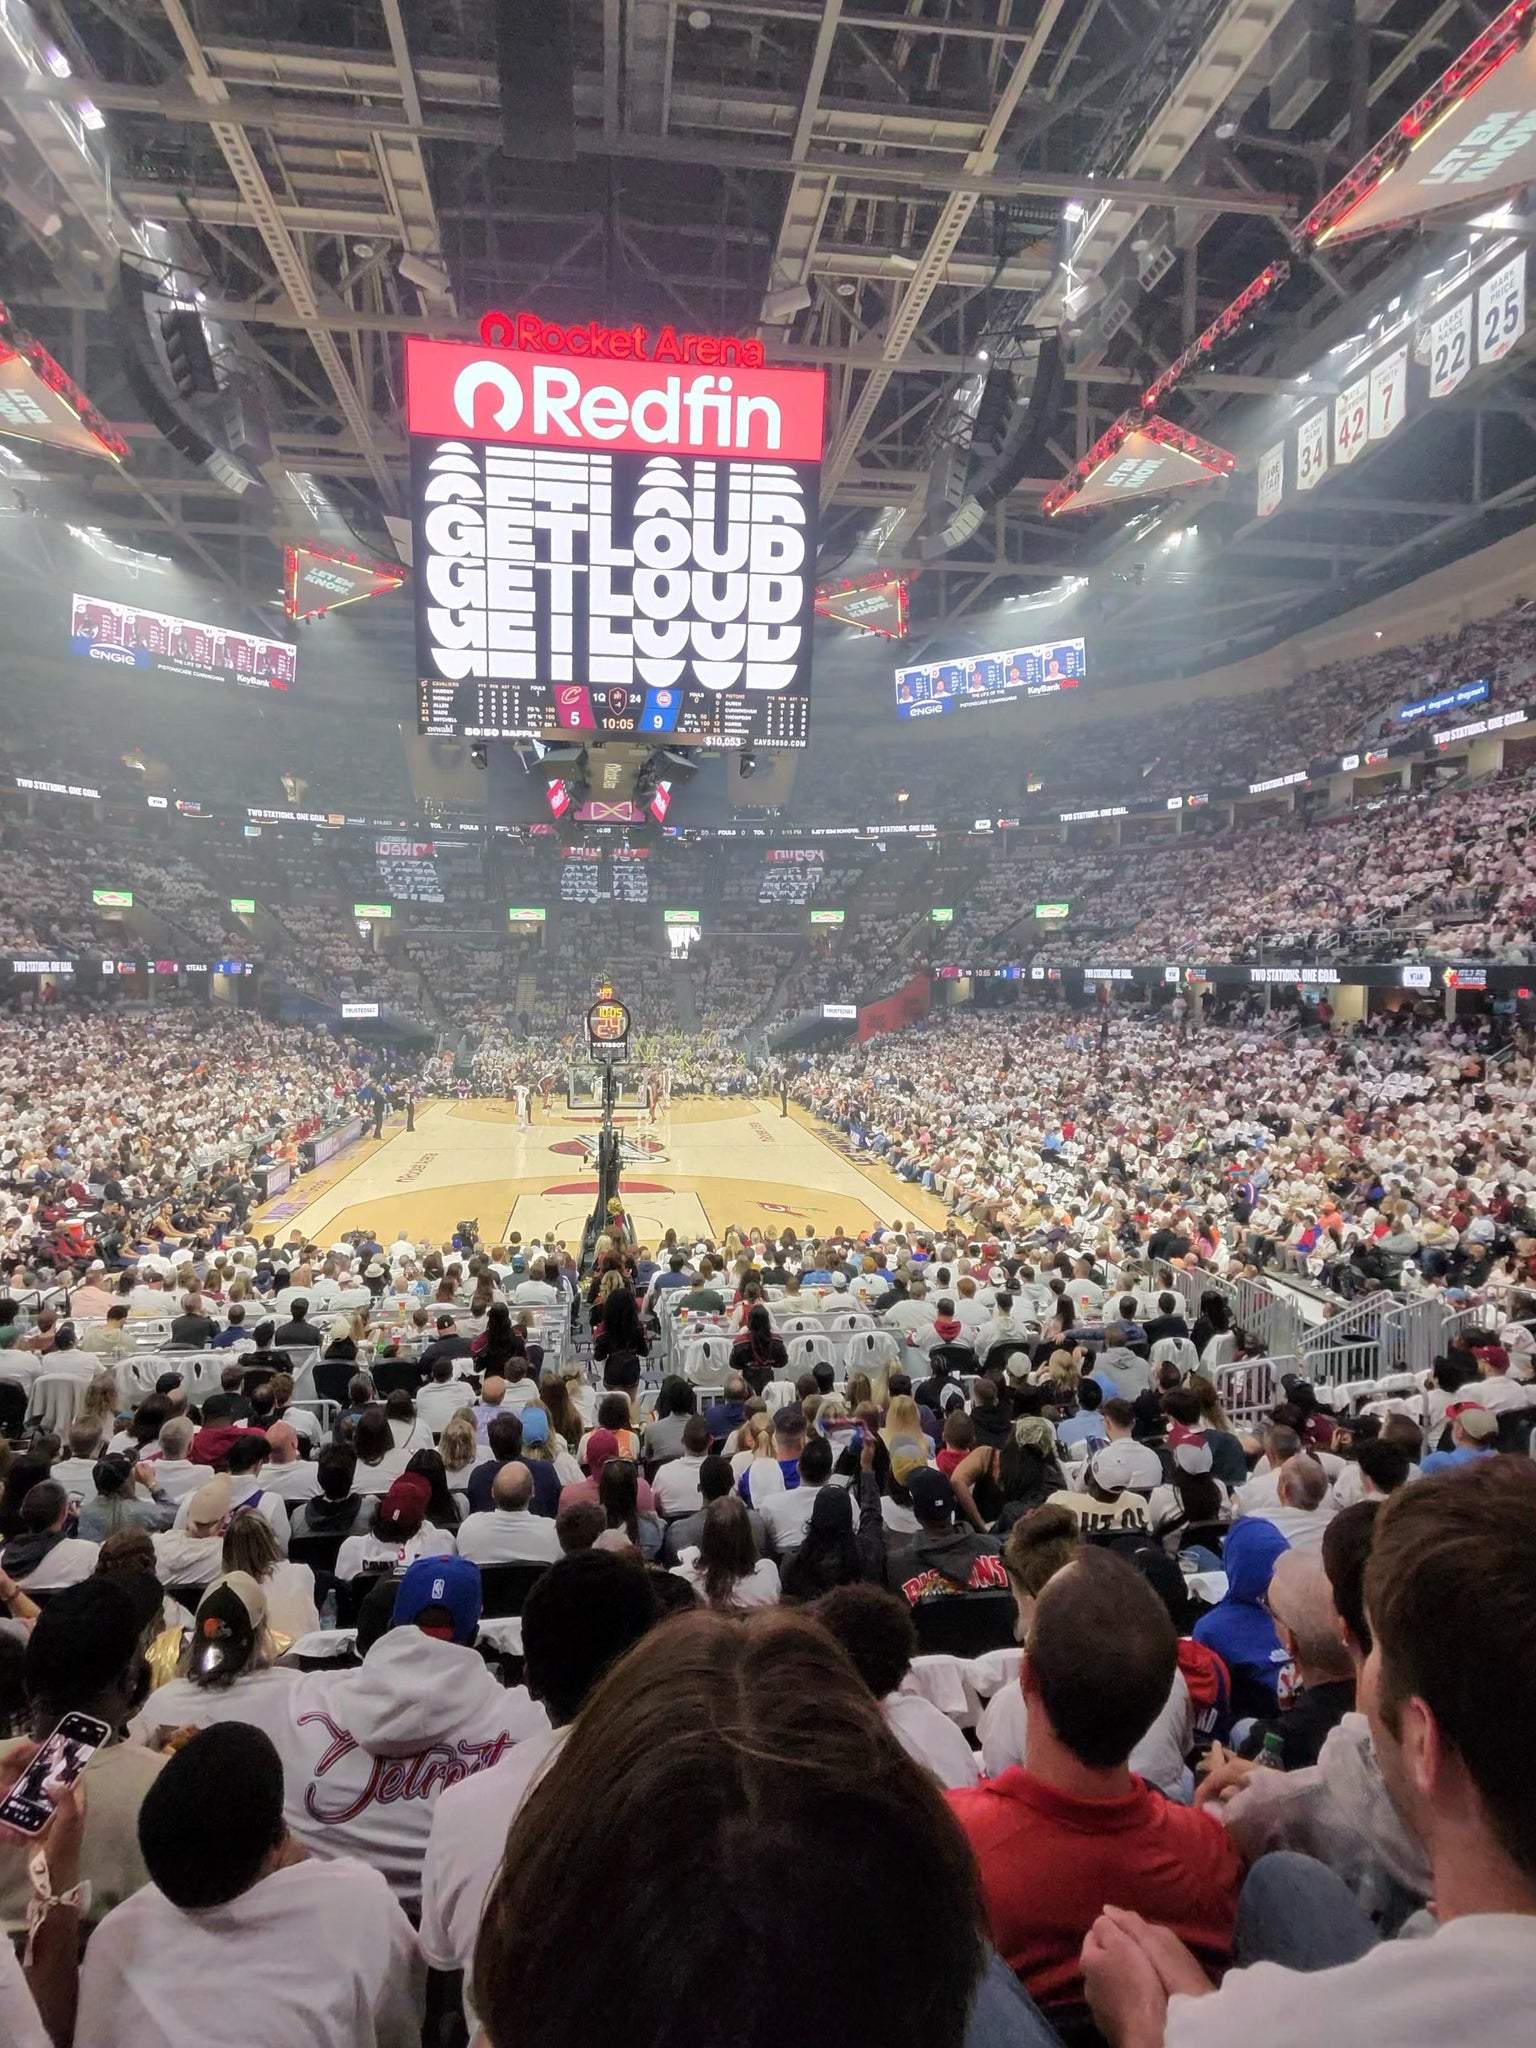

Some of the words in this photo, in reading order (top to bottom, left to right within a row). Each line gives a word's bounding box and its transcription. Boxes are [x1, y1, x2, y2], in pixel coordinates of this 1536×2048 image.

[1418, 148, 1477, 184] LET
[1438, 308, 1464, 332] LARRY
[1484, 290, 1518, 350] 25
[517, 314, 648, 361] Rocket
[655, 327, 765, 368] Arena
[1435, 331, 1466, 384] 22
[533, 364, 781, 449] Redfin
[1382, 384, 1394, 421] 7
[1339, 407, 1364, 449] 42
[1301, 436, 1323, 479] 34
[425, 504, 588, 563] GET
[589, 514, 805, 574] LOUD
[310, 568, 337, 580] LET
[427, 555, 588, 613] GET
[589, 565, 803, 623] LOUD
[237, 673, 270, 688] KeyBank
[1028, 683, 1060, 695] KeyBank
[593, 693, 606, 702] 1Q
[629, 695, 641, 703] 24
[570, 712, 580, 725] 5
[602, 718, 634, 729] 10:05
[653, 715, 663, 729] 9
[427, 725, 453, 733] oswald
[501, 729, 541, 738] RAFFLE
[705, 736, 741, 747] $10,053
[753, 738, 806, 747] CAVS5050.COM
[1251, 969, 1266, 981] TWO
[1267, 969, 1301, 982] STATIONS.
[1301, 969, 1317, 982] ONE
[1318, 969, 1341, 983] GOAL.
[598, 1008, 623, 1017] 10:05
[598, 1017, 620, 1035] 24
[902, 1555, 1008, 1607] PISNS
